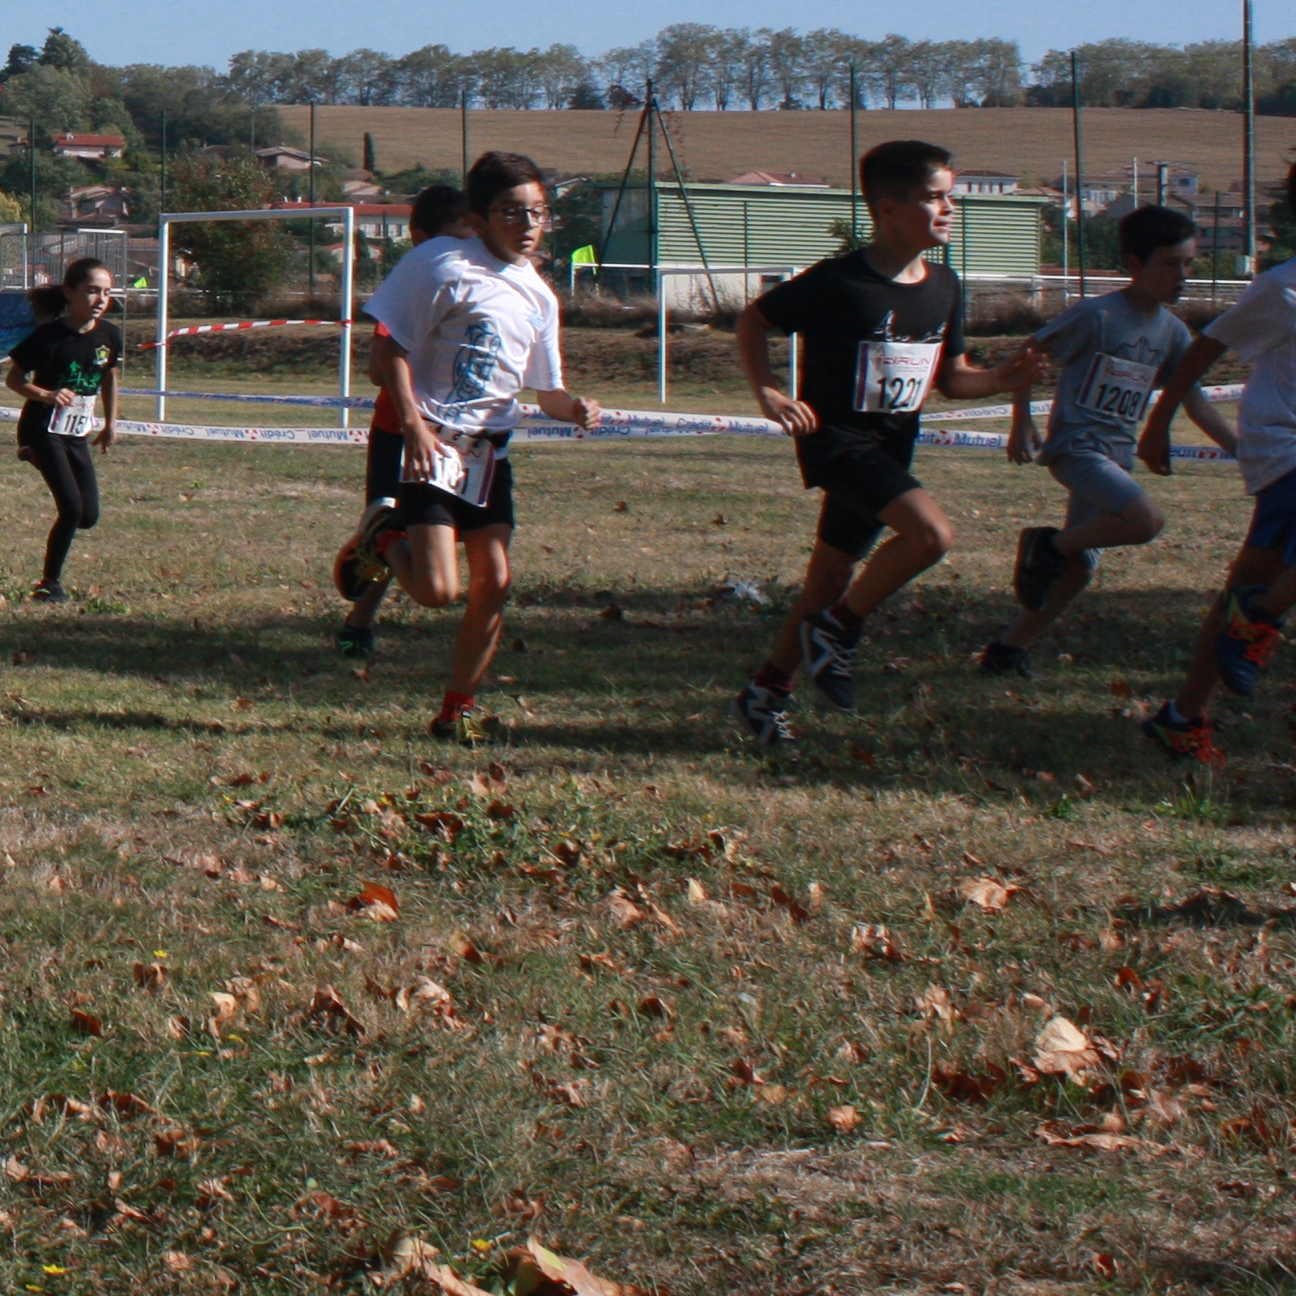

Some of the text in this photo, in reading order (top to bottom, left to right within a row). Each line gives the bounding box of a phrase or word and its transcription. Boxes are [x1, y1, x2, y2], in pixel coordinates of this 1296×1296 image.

[1094, 384, 1142, 418] 1208
[161, 426, 195, 436] Crédit
[206, 427, 246, 438] Mutuel
[259, 429, 296, 439] Crédit
[307, 430, 349, 441] Mutuel
[527, 426, 572, 438] Mutuel
[955, 433, 1002, 448] Mutuel
